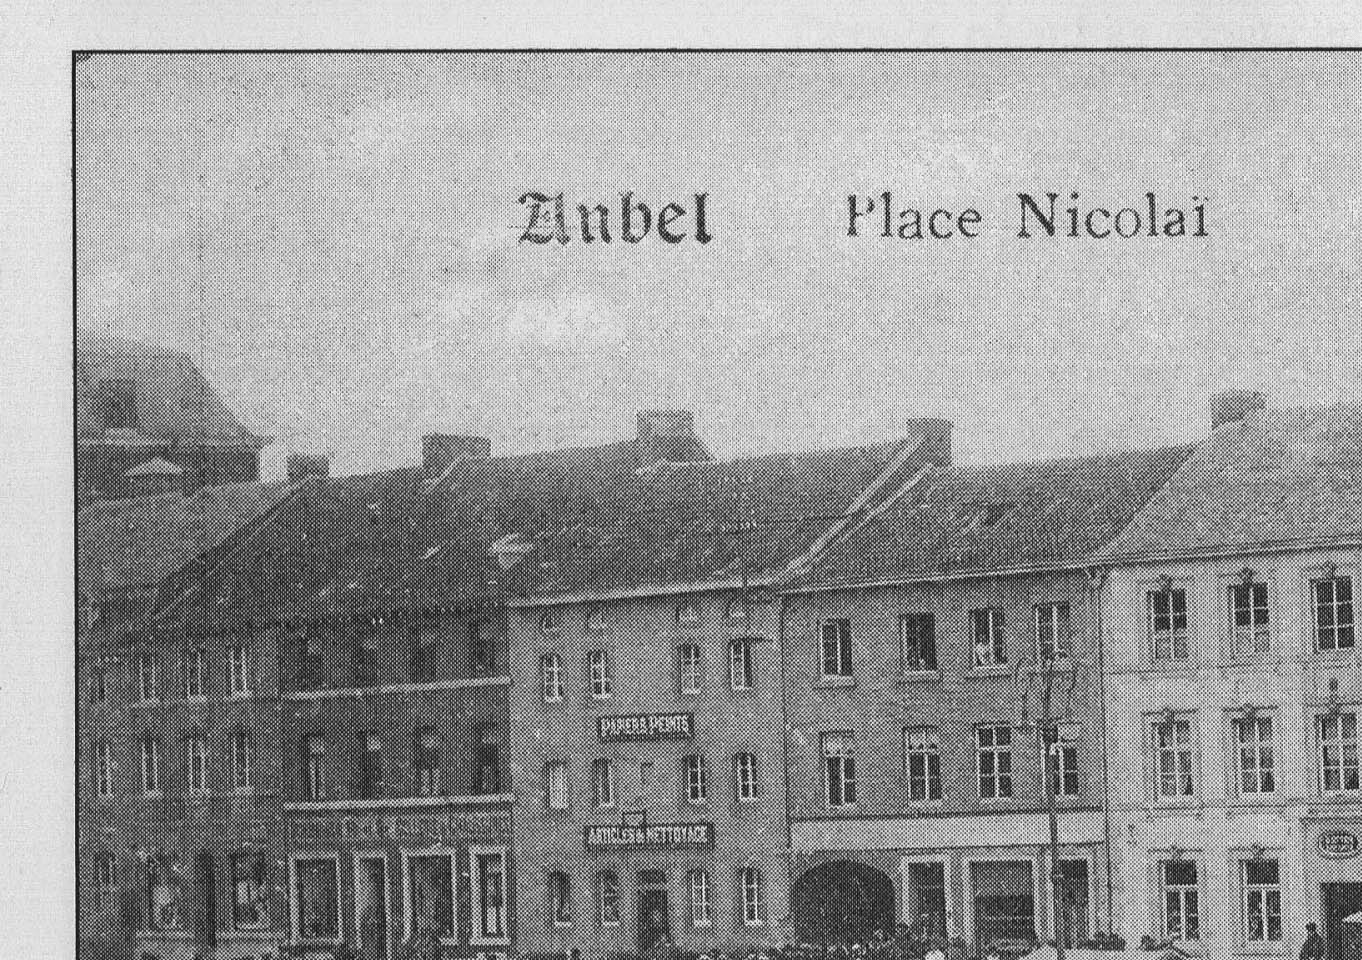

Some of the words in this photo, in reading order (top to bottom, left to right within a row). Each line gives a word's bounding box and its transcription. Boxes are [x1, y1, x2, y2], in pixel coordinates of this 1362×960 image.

[649, 715, 691, 736] PEINTS
[588, 827, 635, 844] ARTICLES
[646, 825, 708, 843] NETTOYAGE
